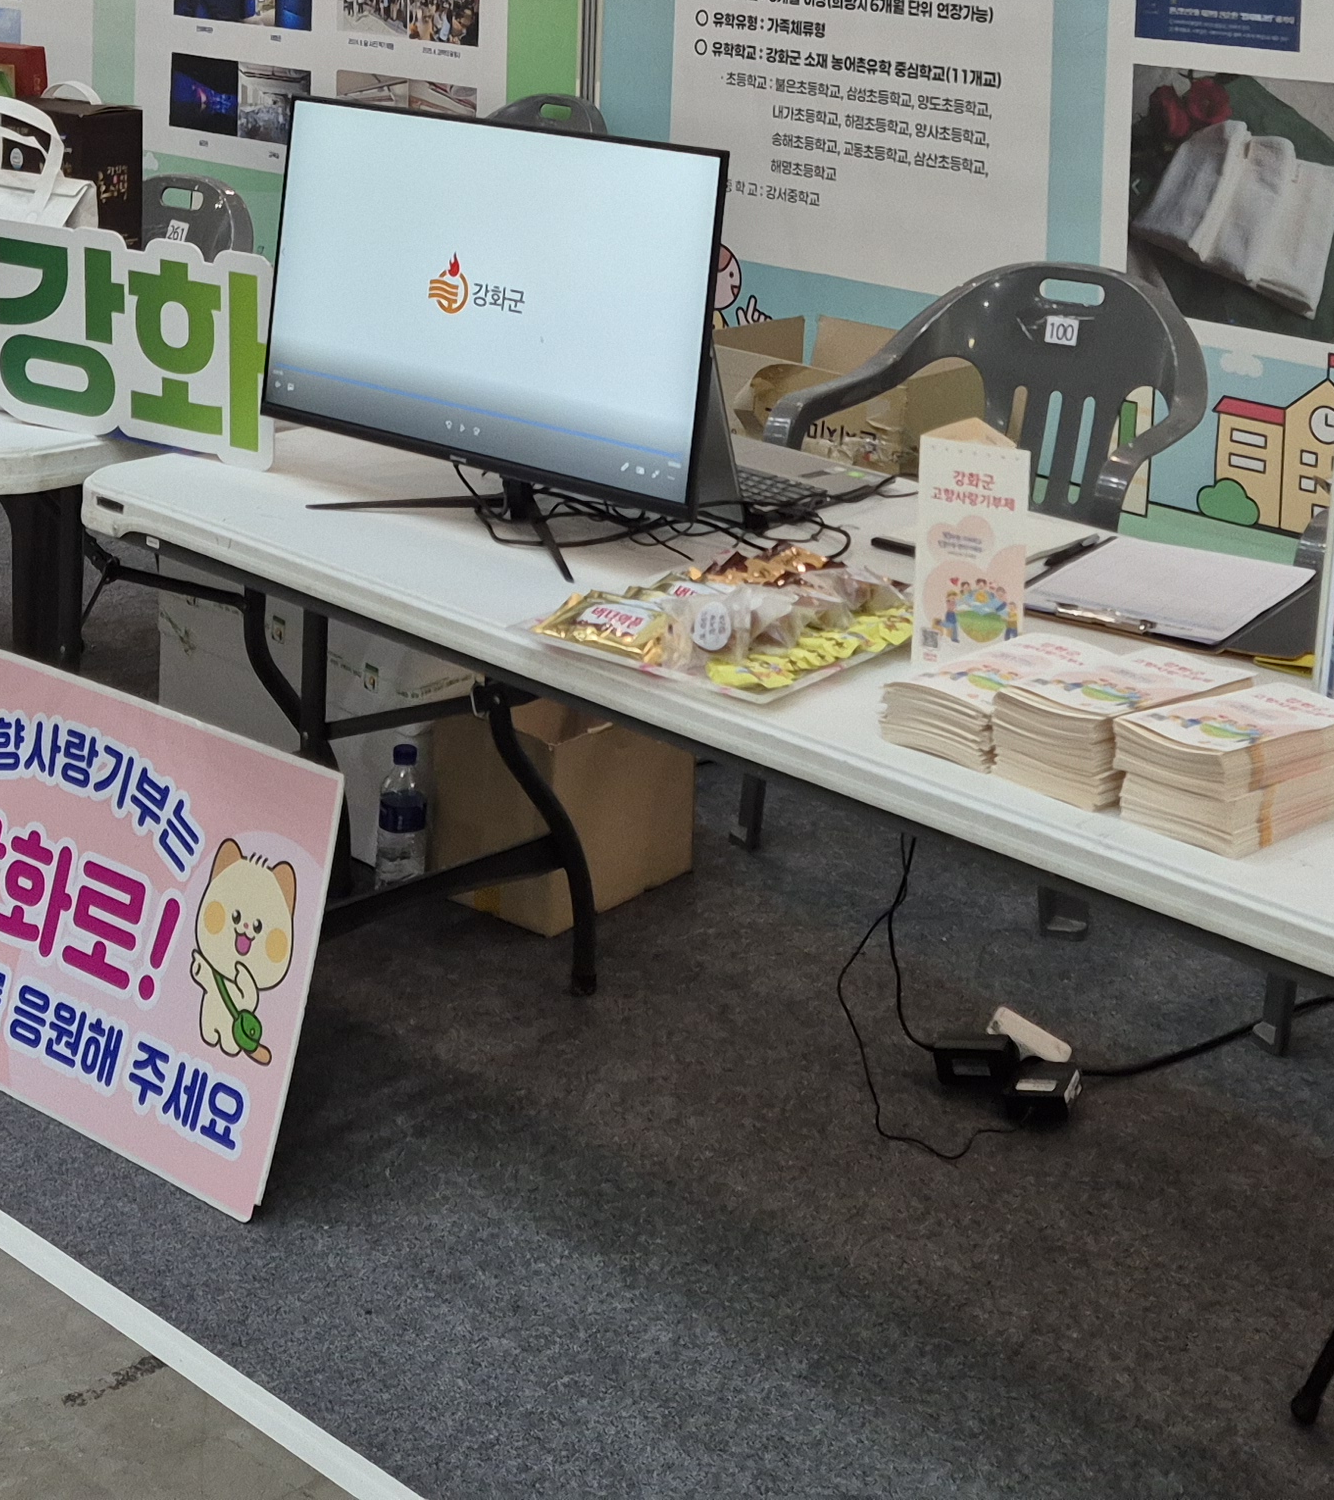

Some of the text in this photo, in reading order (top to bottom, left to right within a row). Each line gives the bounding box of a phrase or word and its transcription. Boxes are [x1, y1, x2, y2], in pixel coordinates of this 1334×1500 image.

[908, 0, 932, 18] 단위
[937, 3, 994, 24] 연장가능)
[767, 18, 826, 38] 가족체류형
[766, 47, 801, 66] 강화군
[804, 51, 828, 69] 소재
[831, 54, 892, 76] 농어촌유학
[894, 61, 1001, 89] 중심학교(11개교)
[773, 105, 841, 129] 내가초등학교,
[772, 132, 989, 178] 송해초등학교, 교동초등학교, 삼산초등학교,
[765, 184, 820, 207] 강서중학교
[168, 224, 185, 241] 261
[472, 281, 526, 315] 강화군
[1049, 322, 1074, 341] 100
[953, 470, 995, 491] 강화군
[931, 486, 1016, 512] 고향사랑기부제
[12, 984, 124, 1088] 응원해
[128, 1040, 244, 1151] 주세요
